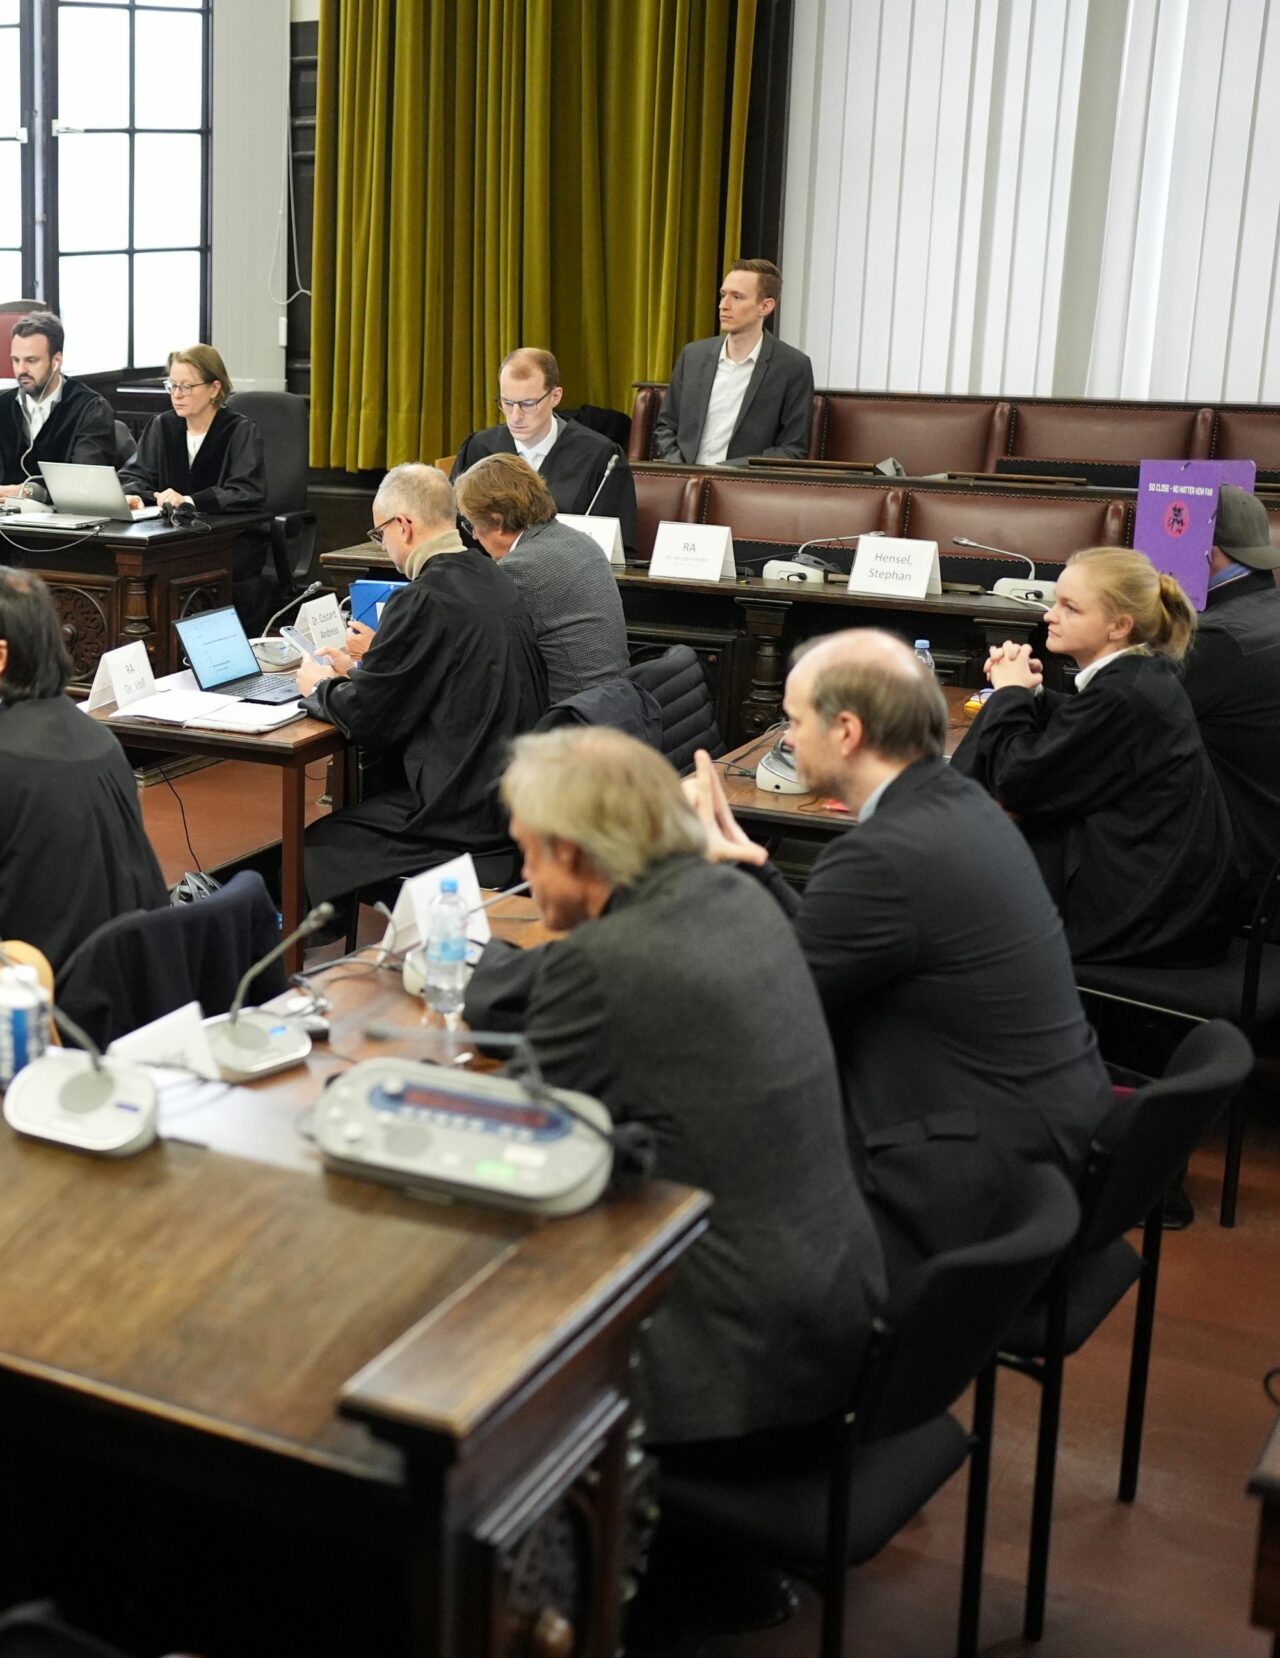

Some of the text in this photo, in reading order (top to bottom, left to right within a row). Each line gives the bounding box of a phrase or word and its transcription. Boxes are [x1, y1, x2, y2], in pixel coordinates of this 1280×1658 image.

[1148, 482, 1155, 491] SO
[1156, 483, 1169, 492] CLOSE
[1173, 485, 1179, 493] NO
[1179, 486, 1195, 495] MATTER
[1205, 488, 1213, 497] FAR
[682, 542, 696, 552] RA
[874, 552, 913, 567] Hensel,
[868, 568, 912, 582] Stephan
[125, 663, 135, 674] RA
